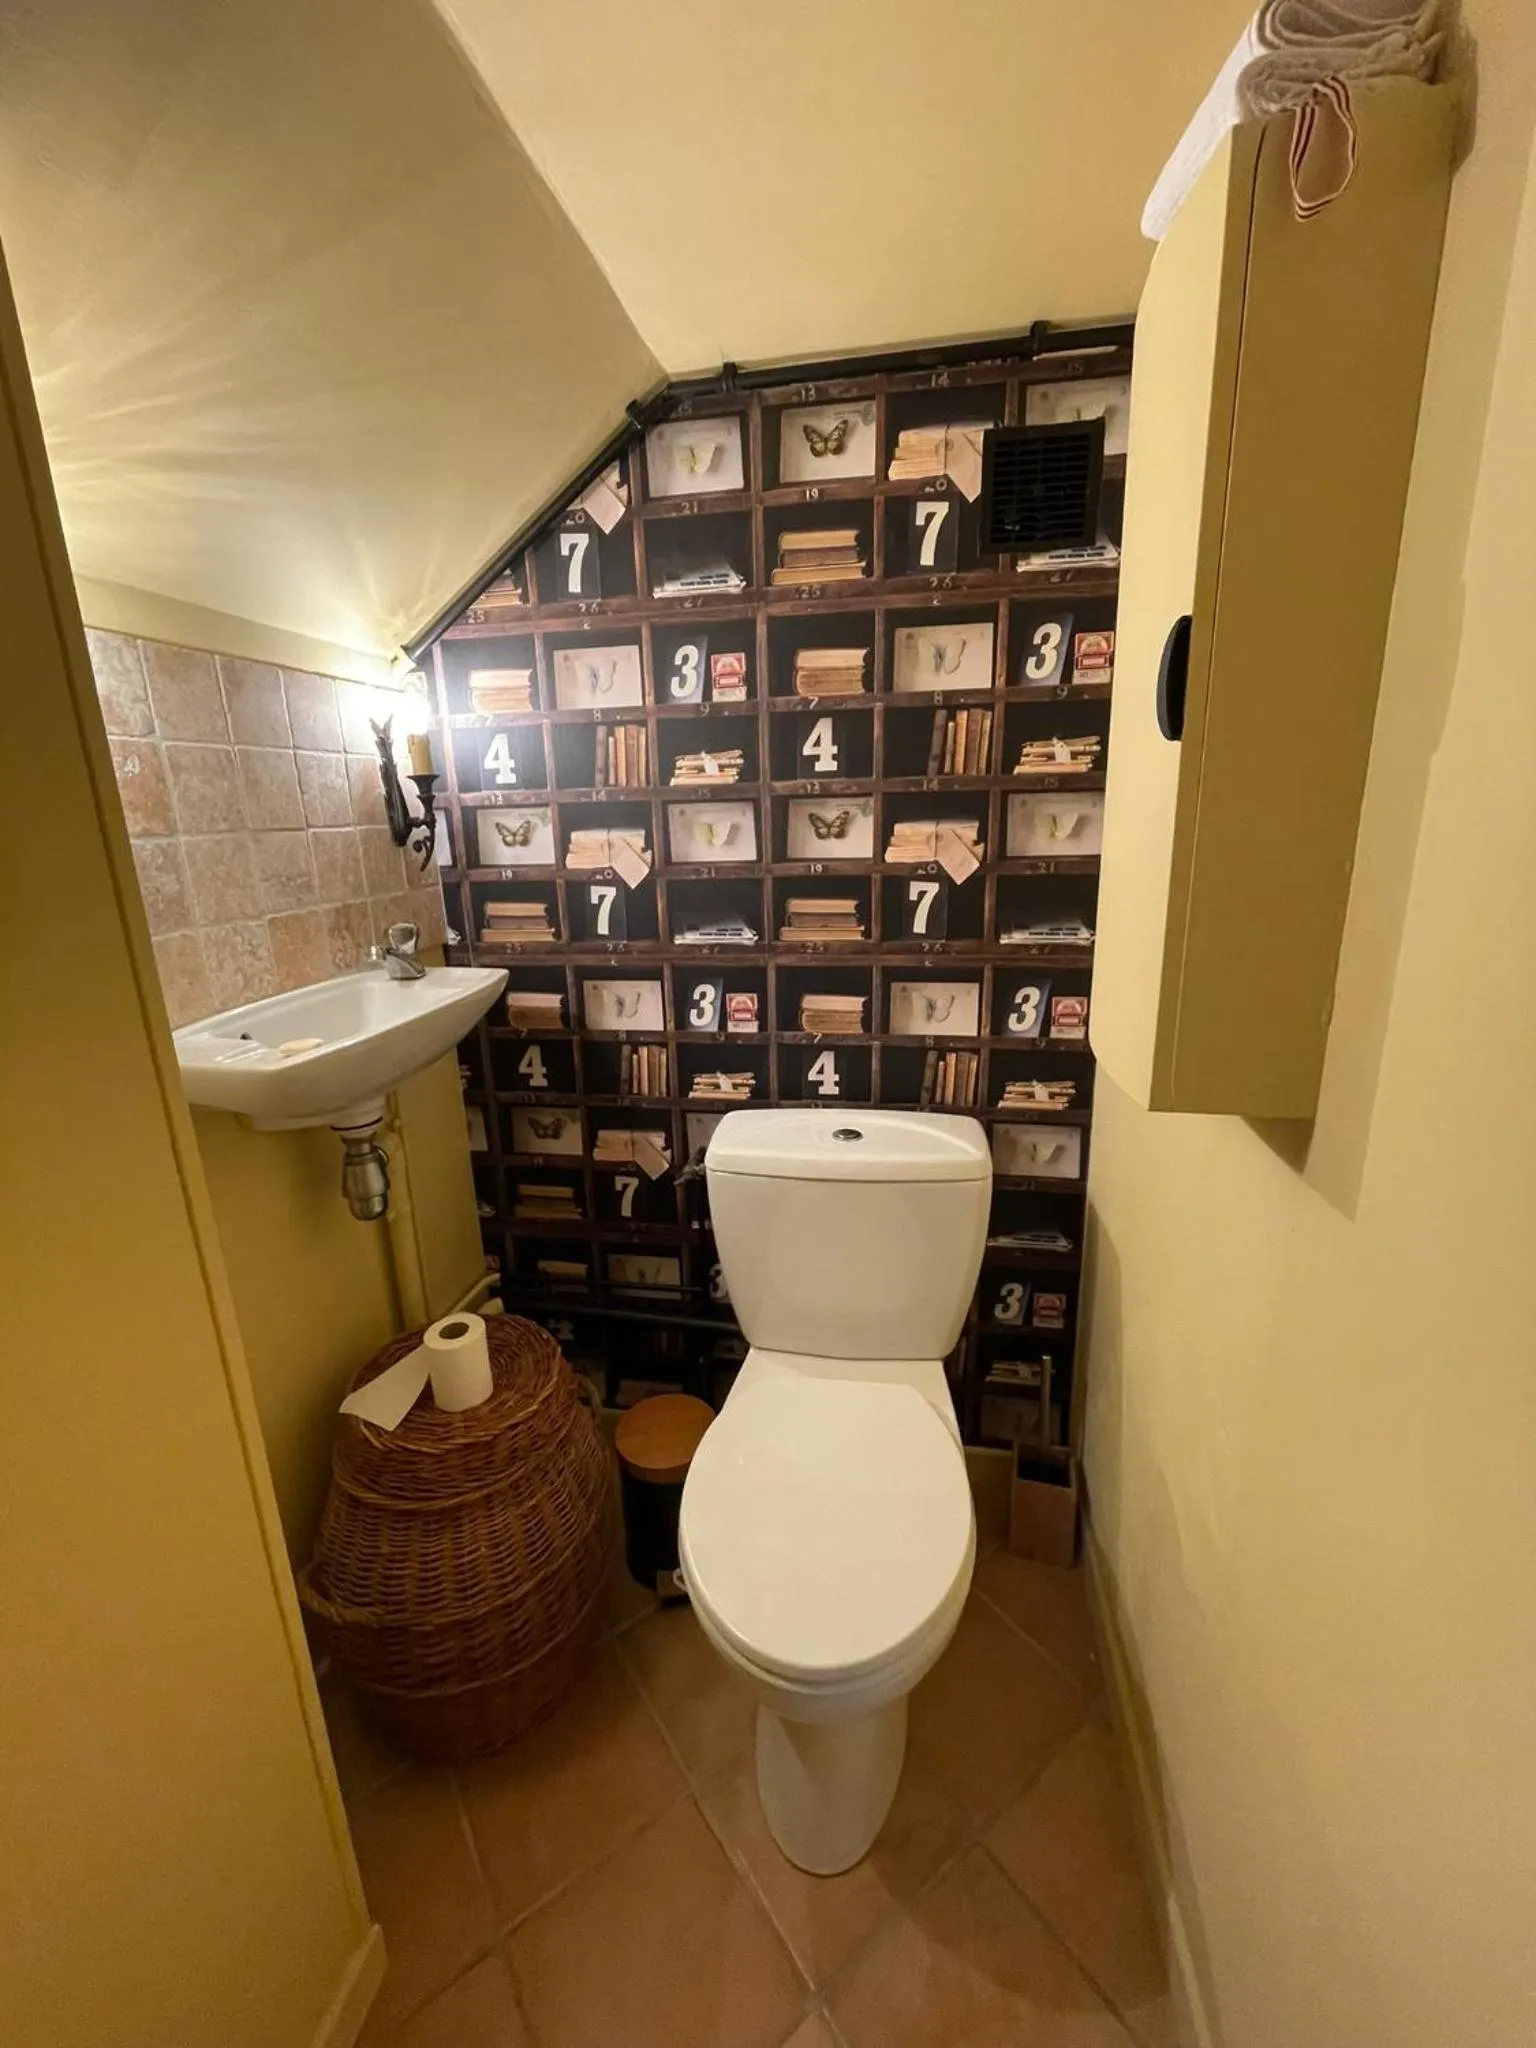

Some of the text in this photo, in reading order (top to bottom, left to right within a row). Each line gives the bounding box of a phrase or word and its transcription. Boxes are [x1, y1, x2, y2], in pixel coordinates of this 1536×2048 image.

[916, 501, 949, 566] 7
[560, 533, 589, 593] 7
[670, 645, 699, 698] 3
[1026, 622, 1061, 679] 3
[484, 734, 516, 784] 4
[802, 718, 838, 772] 4
[590, 886, 616, 935] 7
[908, 881, 939, 934] 7
[689, 984, 715, 1026] 3
[1008, 987, 1041, 1032] 3
[519, 1045, 547, 1087] 4
[808, 1051, 840, 1095] 4
[614, 1176, 640, 1218] 7
[994, 1283, 1023, 1320] 3
